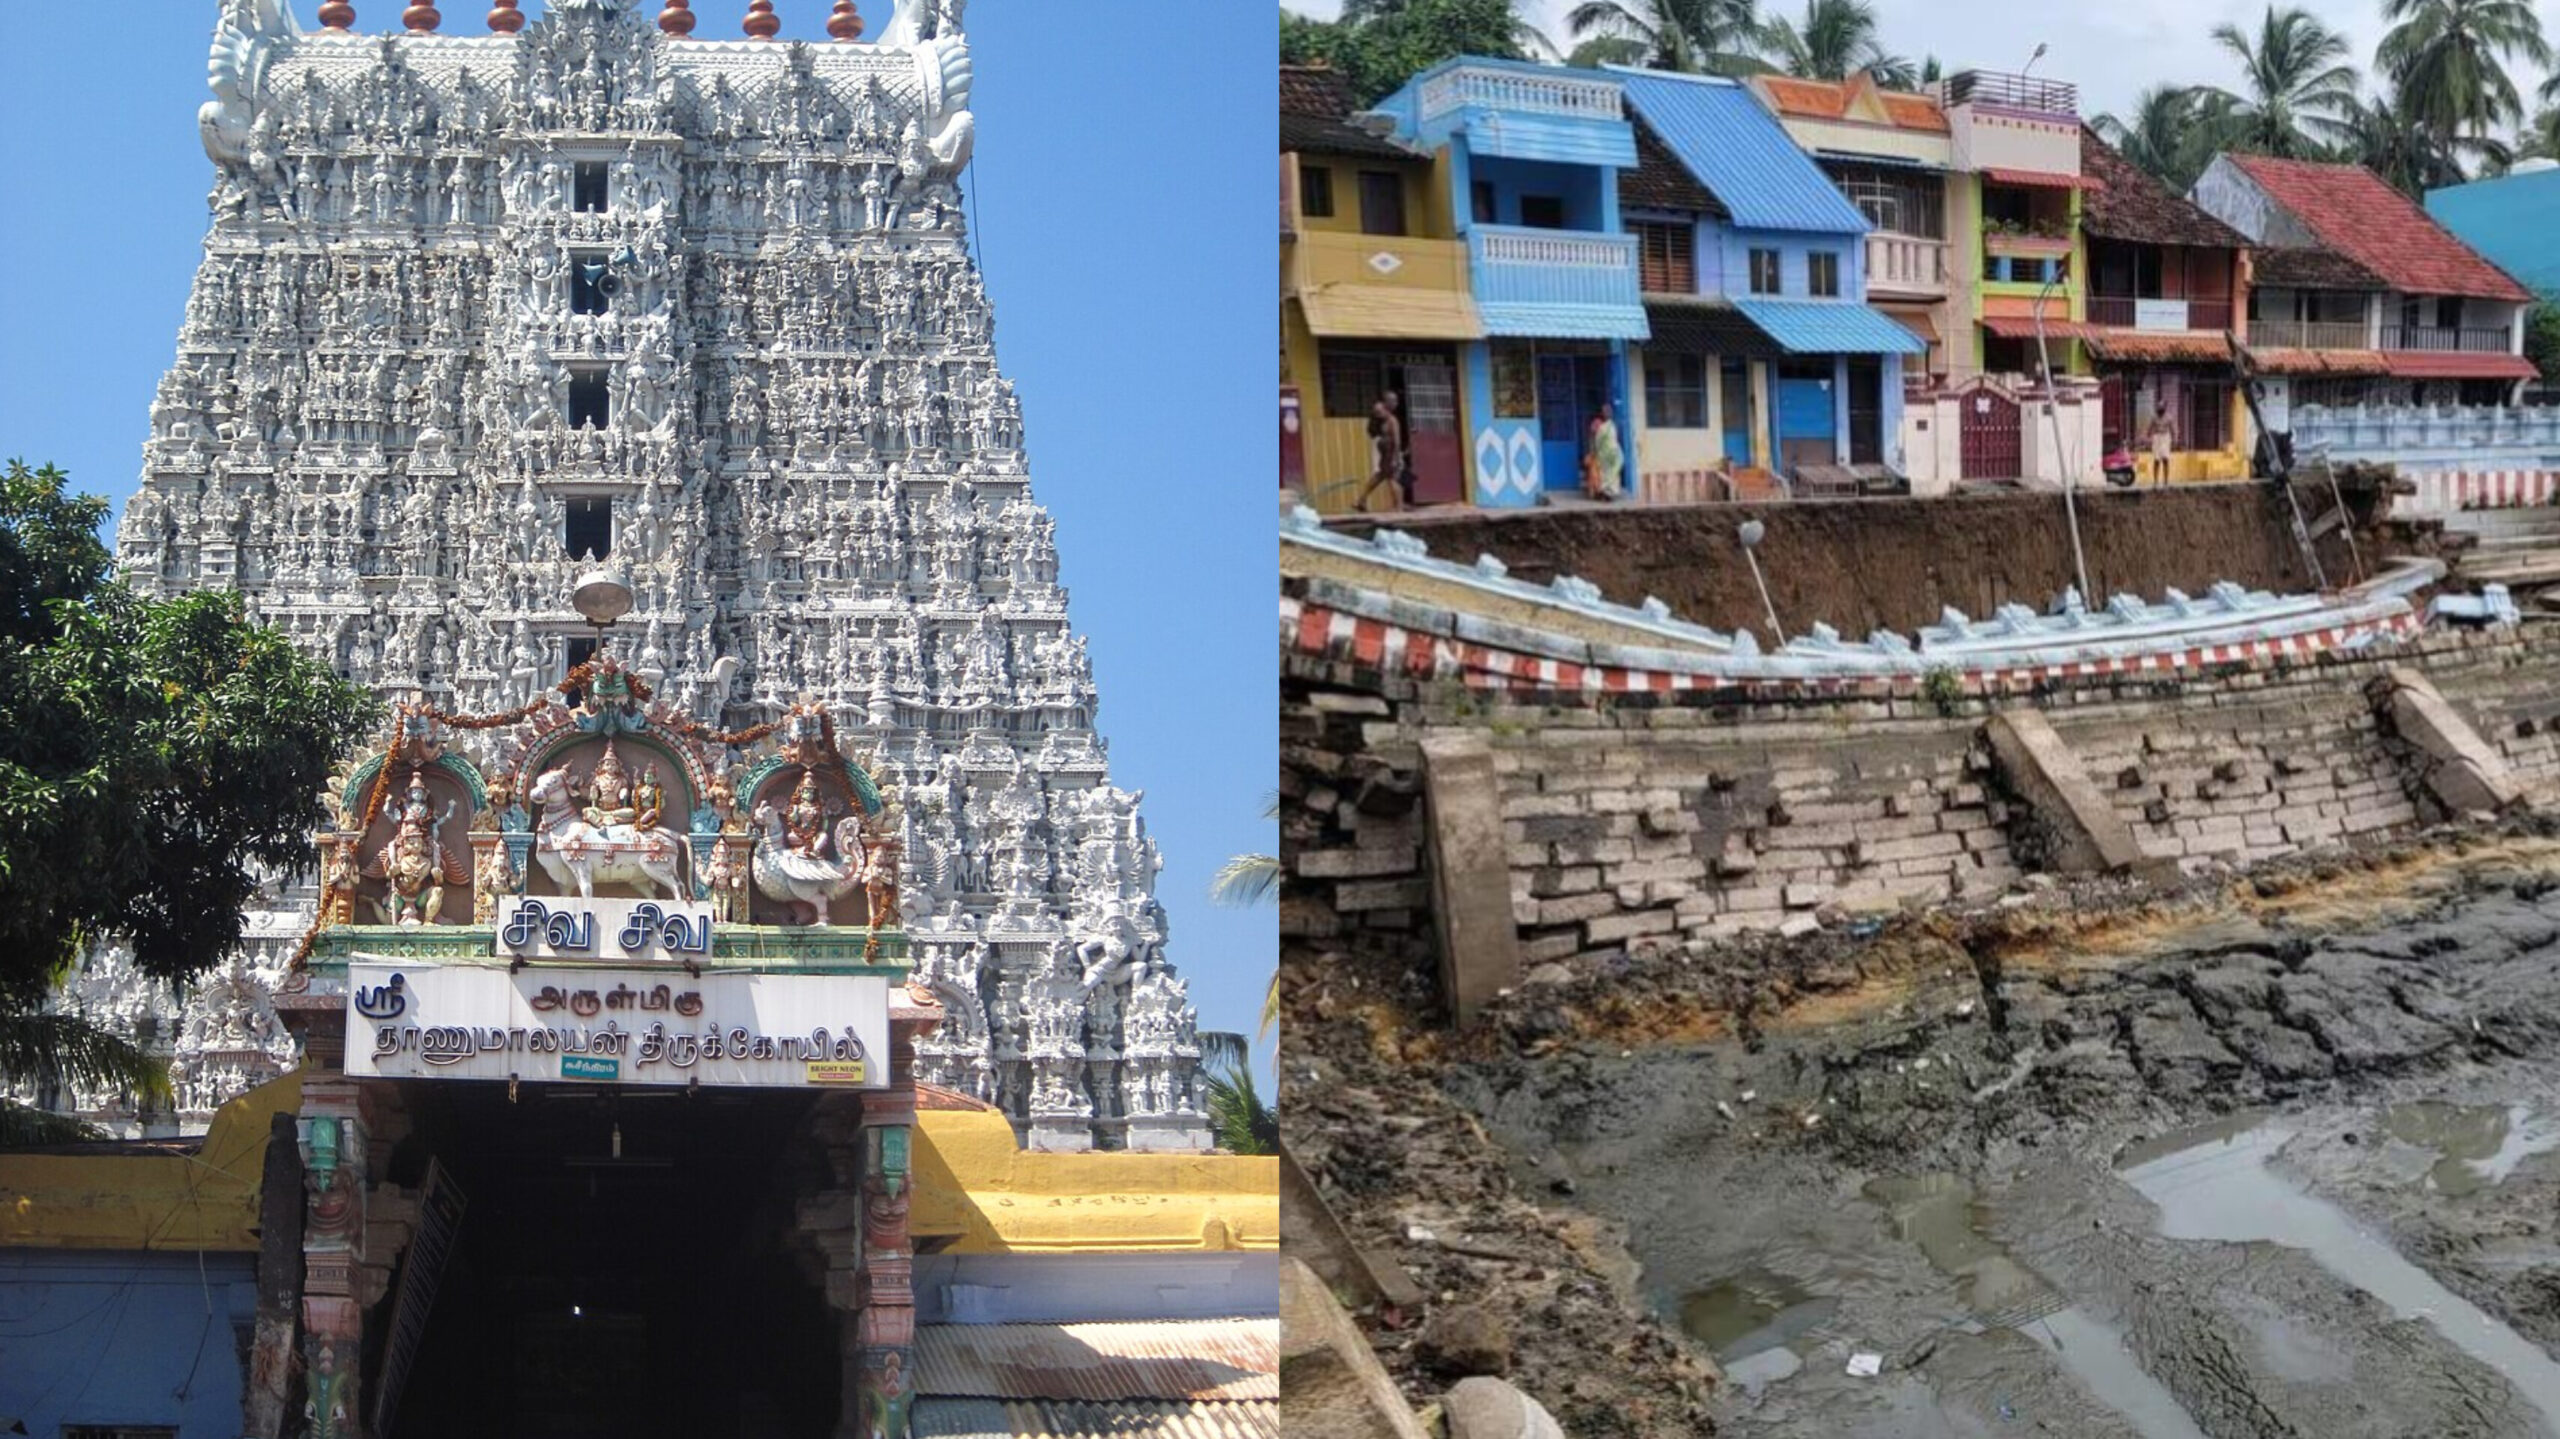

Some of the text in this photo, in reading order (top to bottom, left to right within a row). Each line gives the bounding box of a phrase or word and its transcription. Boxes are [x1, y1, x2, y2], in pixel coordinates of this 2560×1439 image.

[502, 899, 708, 954] சிவ சிவ
[530, 982, 703, 1017] அருள்மிகு
[371, 1020, 864, 1069] தாணுமாலயன் திருக்கோயில்
[810, 1065, 862, 1073] BRIGHT NEON
